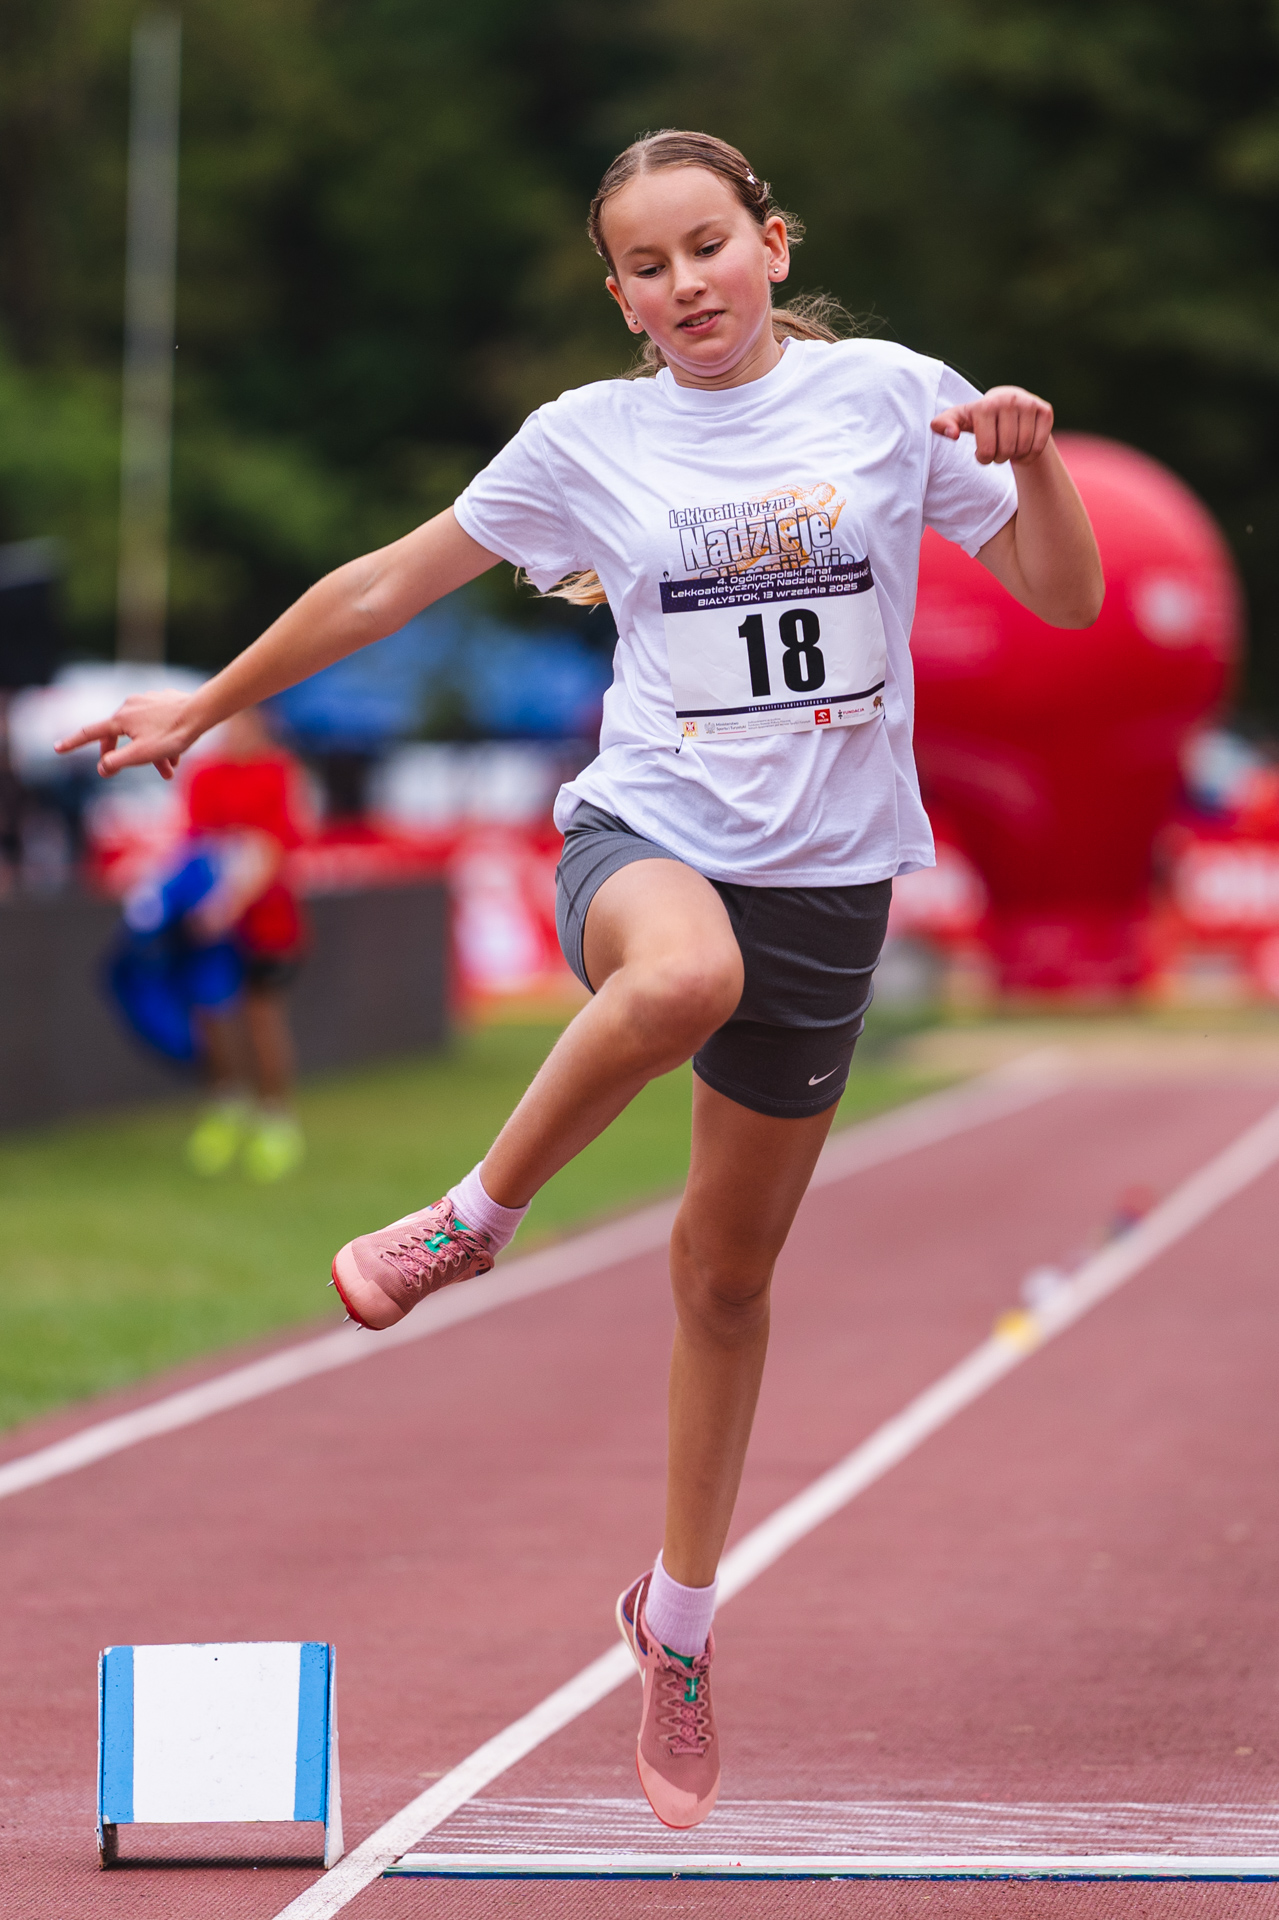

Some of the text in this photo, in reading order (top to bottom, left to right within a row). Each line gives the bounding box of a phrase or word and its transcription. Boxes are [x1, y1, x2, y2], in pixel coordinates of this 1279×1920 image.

[669, 496, 795, 528] Lekkoatletyczne
[679, 507, 832, 571] Nadzieje
[671, 580, 774, 598] Lekkoatletycznych
[777, 575, 817, 587] Nadziei
[717, 577, 727, 585] 4.
[730, 568, 802, 584] Ogólnopolski
[697, 582, 858, 607] BIAŁYSTOK, 13 września 2025
[738, 608, 826, 697] 18
